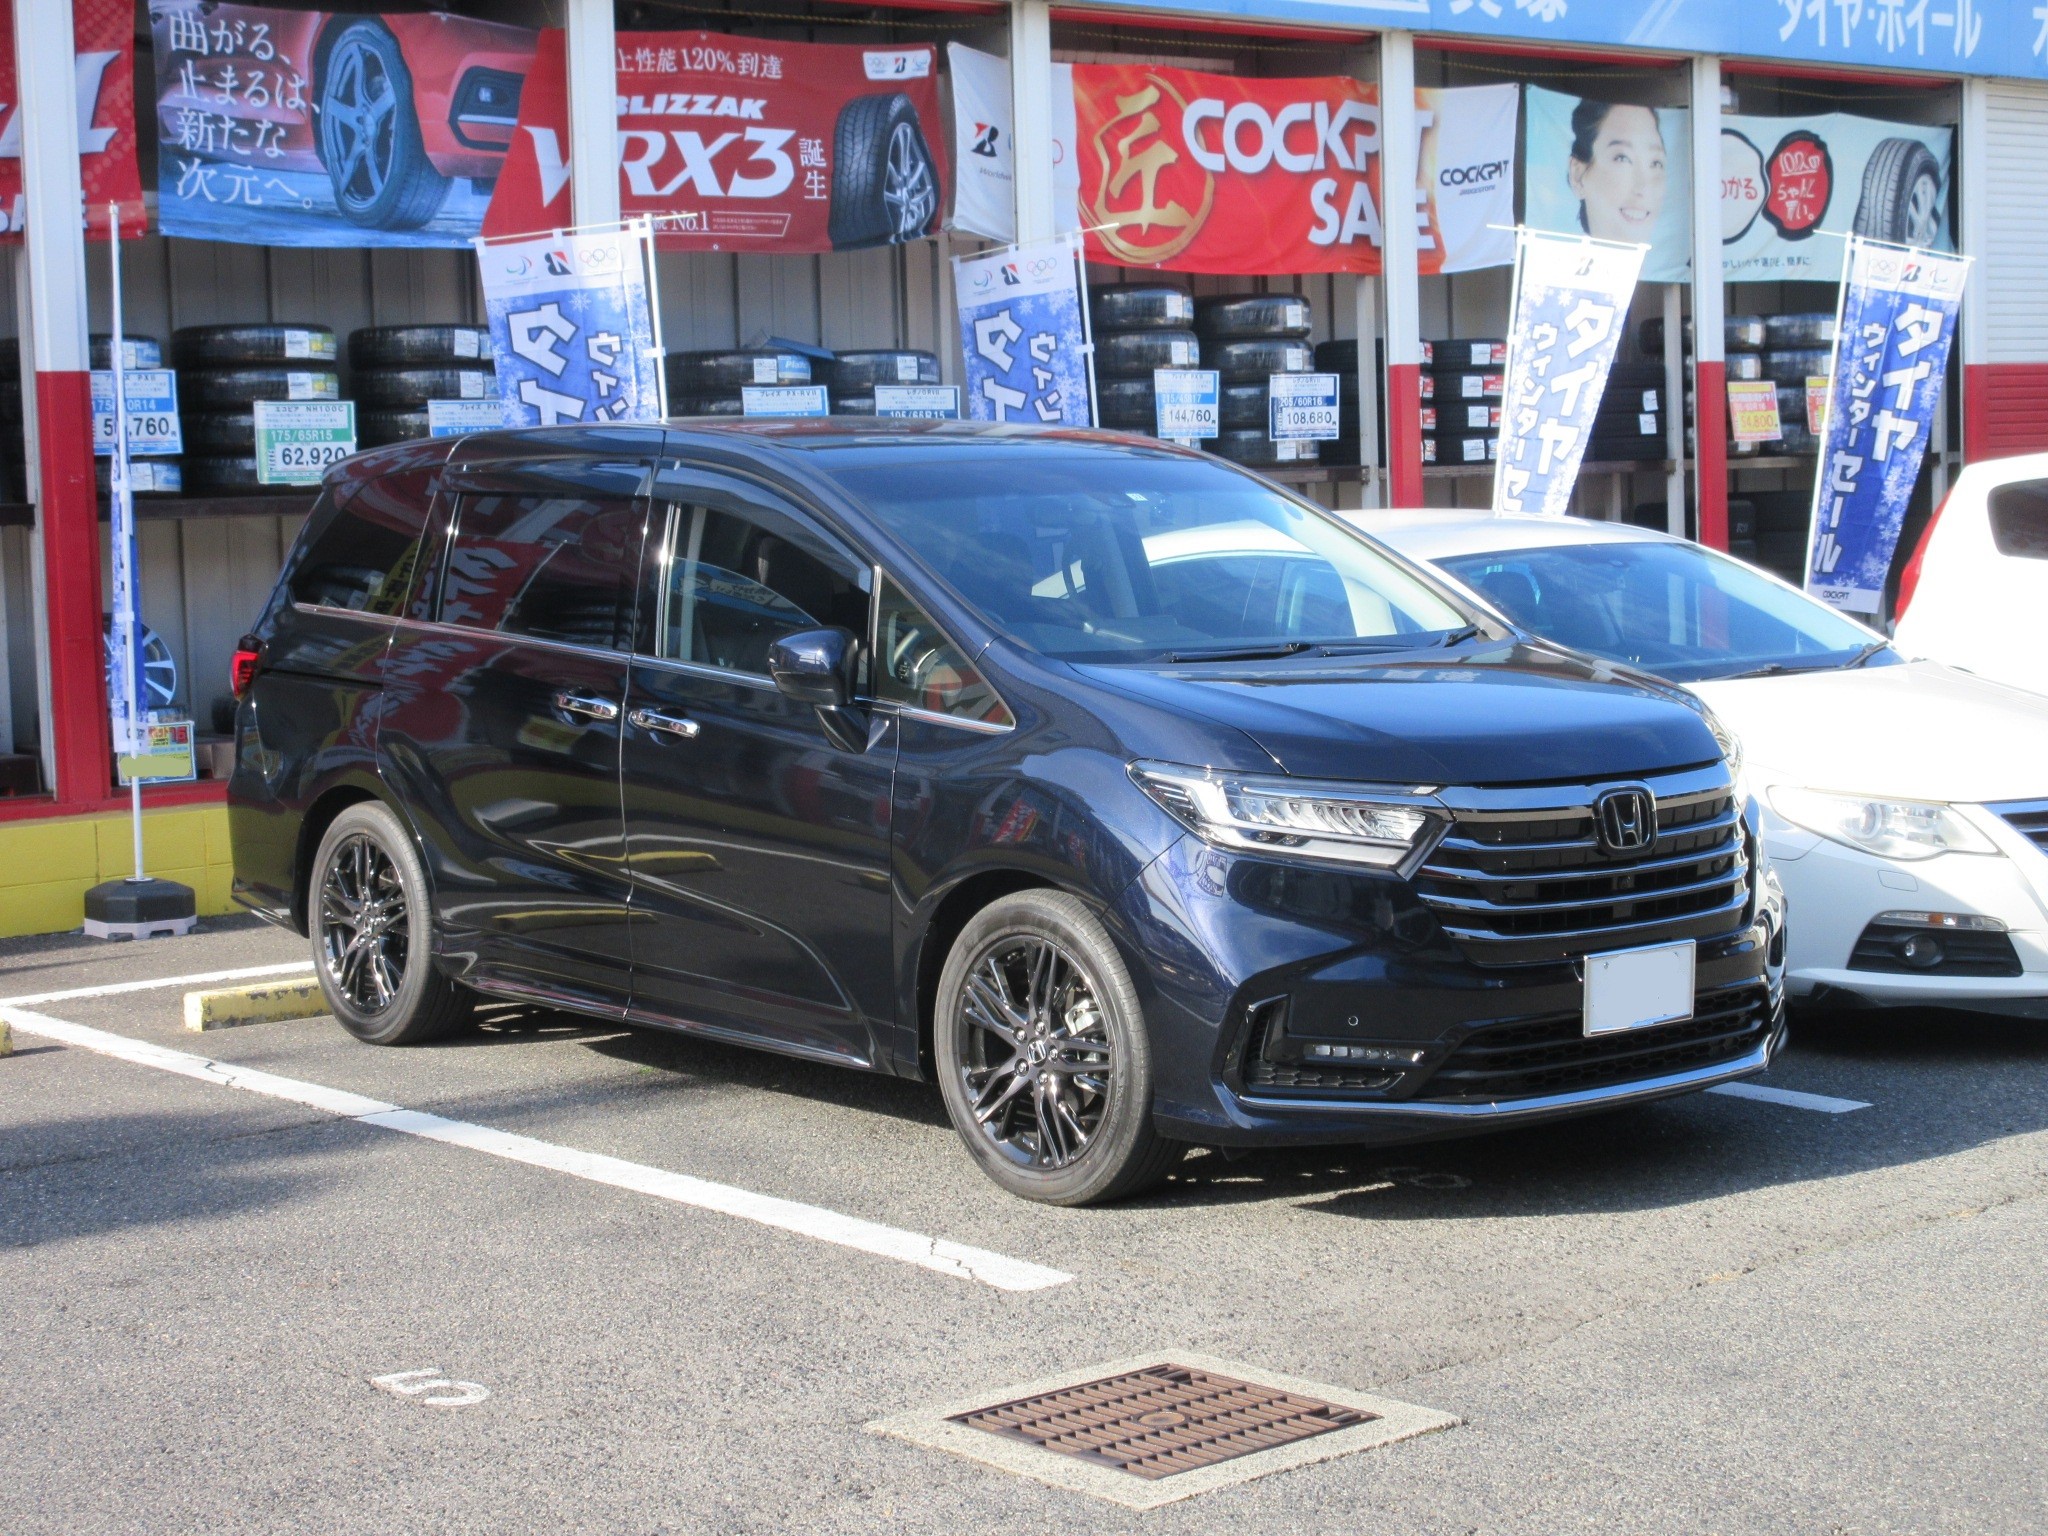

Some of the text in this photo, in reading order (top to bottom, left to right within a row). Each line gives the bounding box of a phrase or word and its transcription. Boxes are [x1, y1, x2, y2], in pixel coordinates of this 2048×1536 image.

[169, 9, 291, 65] 曲がる、
[174, 58, 321, 115] 止まるは、
[616, 93, 768, 120] BLIZZAK
[176, 105, 288, 159] 新たな
[1182, 96, 1435, 174] COCKPT
[176, 156, 314, 209] 次元へ。
[521, 125, 797, 208] VRX3
[798, 137, 828, 200] 誕生
[1440, 159, 1510, 187] COCKPIT
[275, 405, 345, 413] エコピア NH100C
[1537, 296, 1616, 476] タイヤ
[1870, 302, 1944, 462] タイヤ
[270, 428, 334, 442] 175/65R15
[281, 446, 347, 466] 62,920
